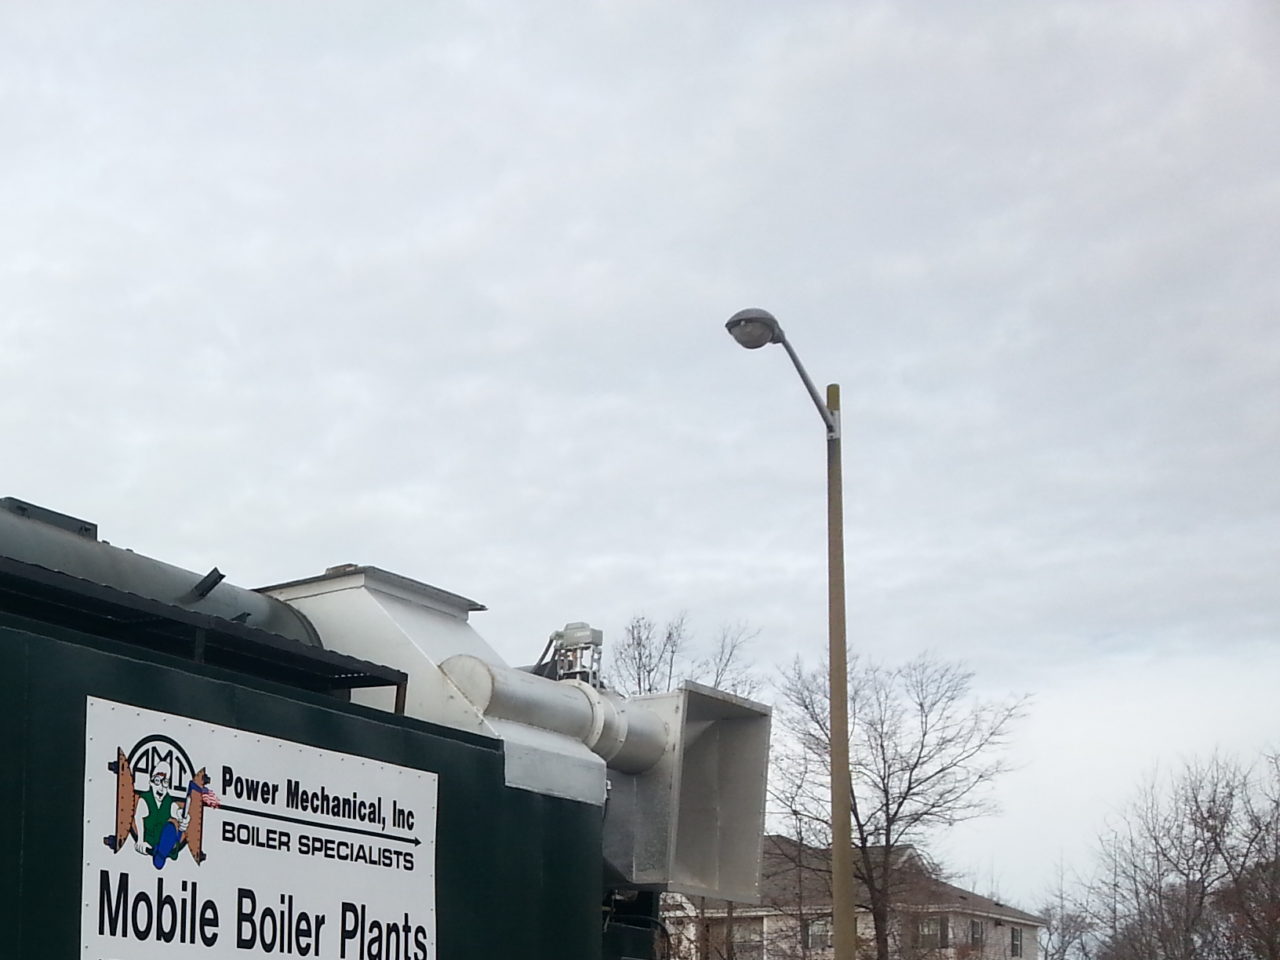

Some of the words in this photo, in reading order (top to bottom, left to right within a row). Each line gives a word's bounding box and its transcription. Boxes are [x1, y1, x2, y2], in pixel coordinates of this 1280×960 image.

[222, 765, 278, 805] Power
[286, 778, 386, 831] Mechanical,
[393, 800, 415, 831] Inc
[222, 821, 292, 852] BOILER
[298, 835, 415, 871] SPECIALISTS
[98, 869, 220, 948] Mobile
[236, 887, 326, 957] Boiler
